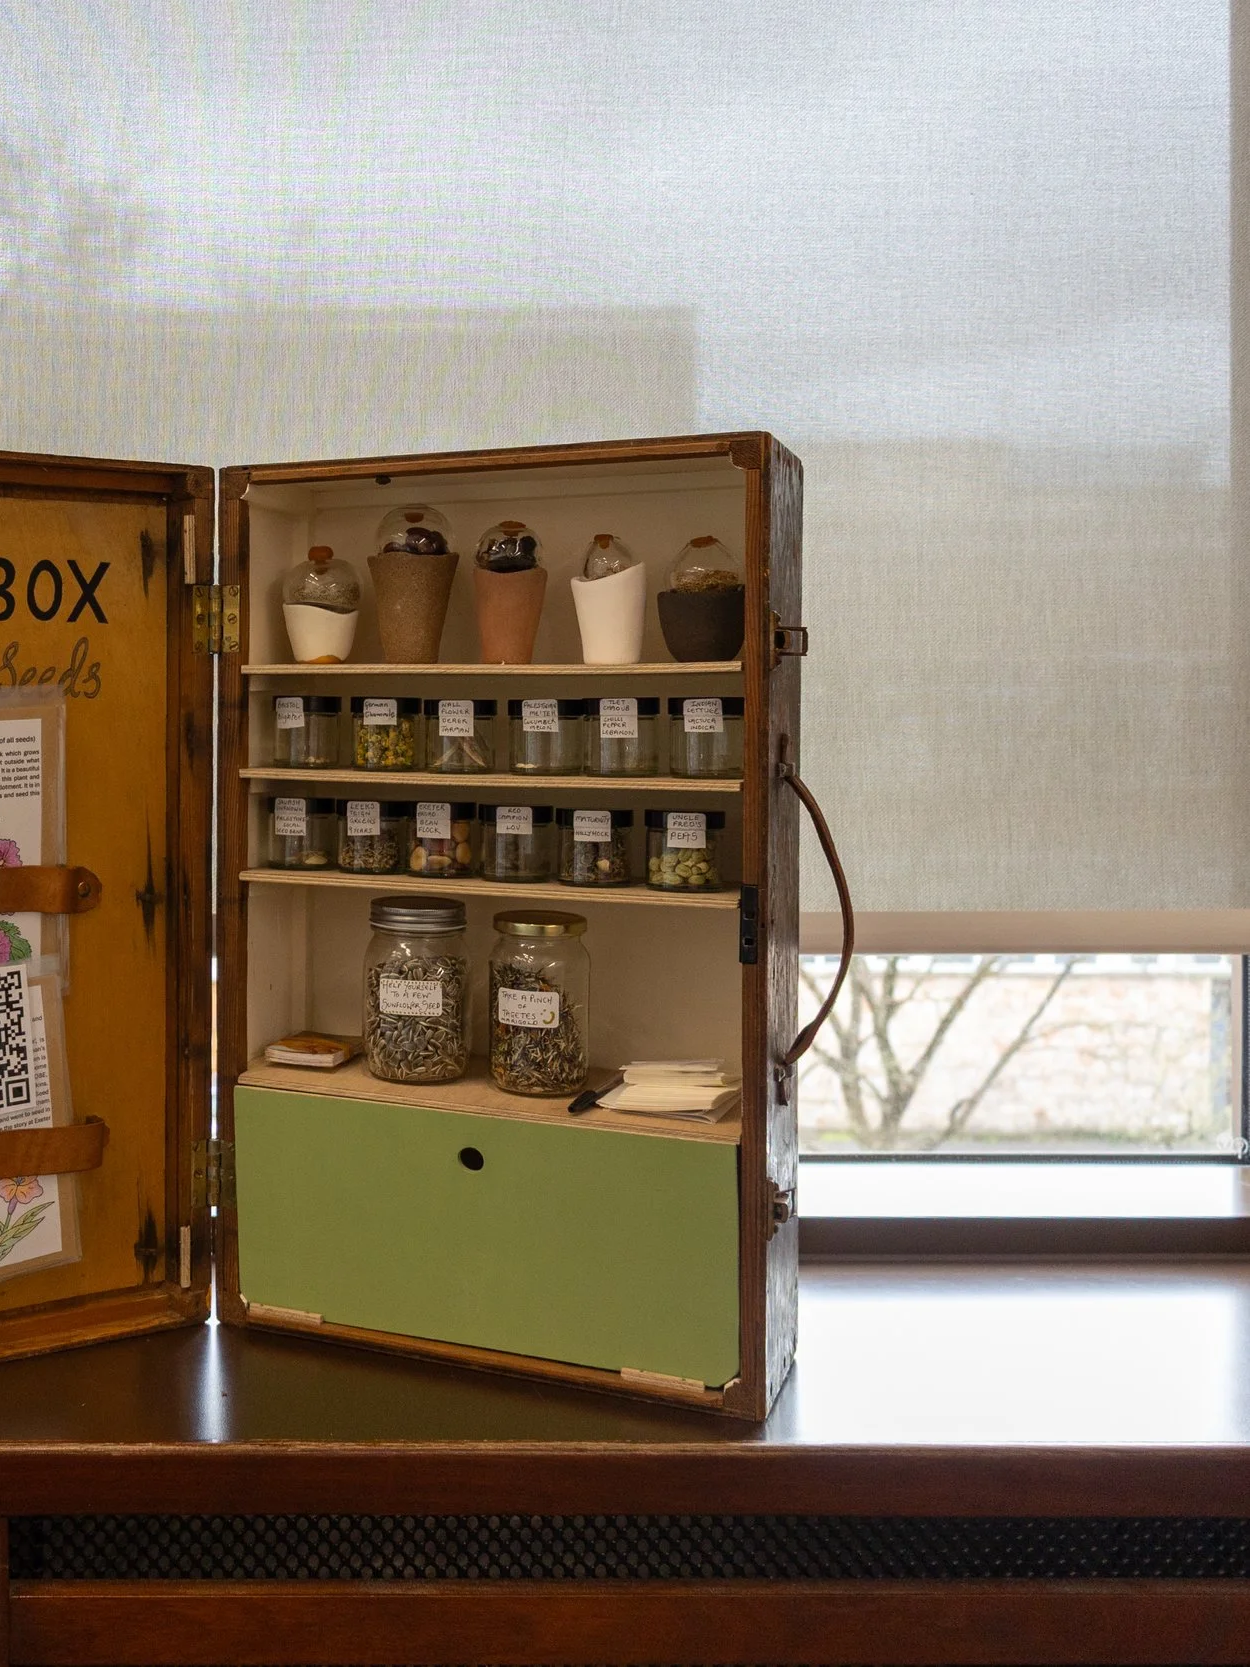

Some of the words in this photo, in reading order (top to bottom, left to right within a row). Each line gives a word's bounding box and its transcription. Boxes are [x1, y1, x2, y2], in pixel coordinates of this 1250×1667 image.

[672, 820, 702, 828] FRED'S
[670, 831, 698, 842] PEAS
[502, 991, 517, 1001] TAKE
[530, 994, 553, 1005] PINCH
[10, 1112, 24, 1120] went
